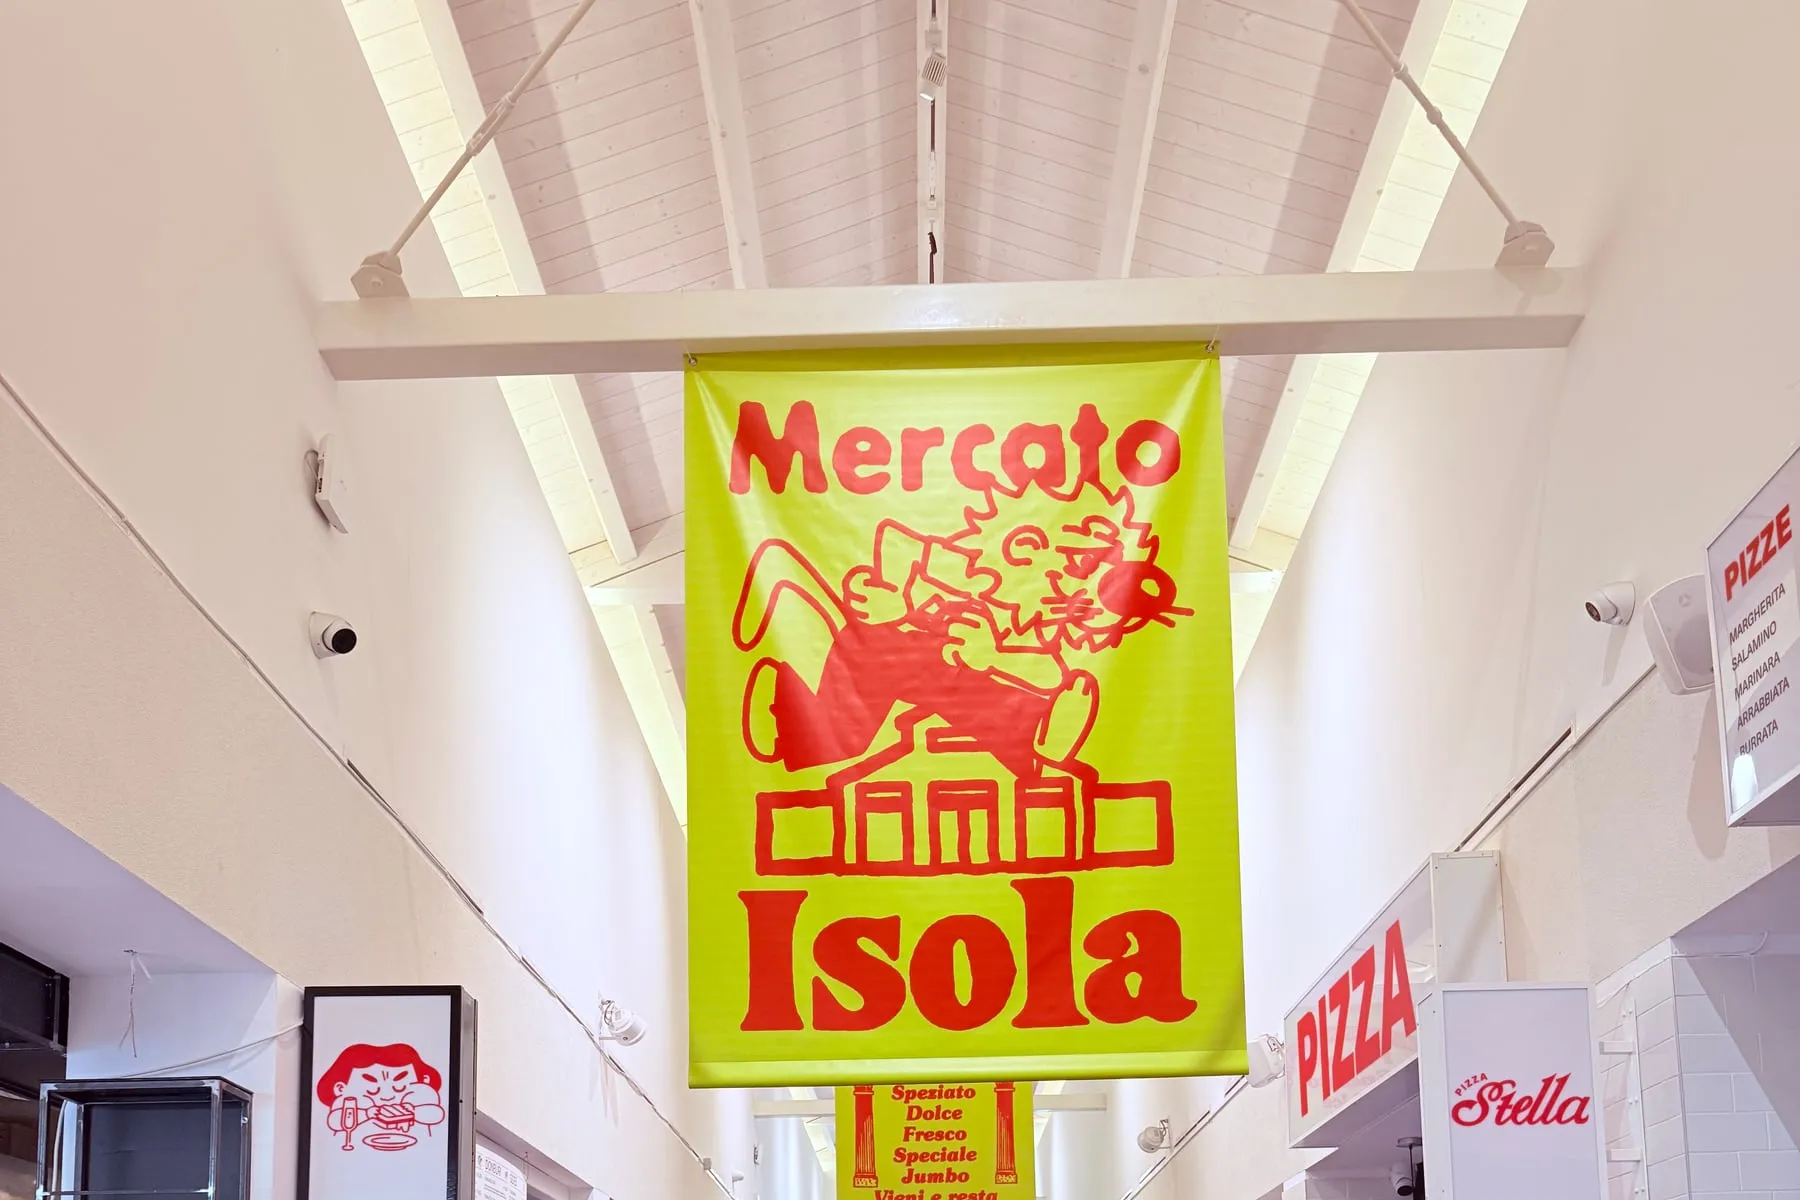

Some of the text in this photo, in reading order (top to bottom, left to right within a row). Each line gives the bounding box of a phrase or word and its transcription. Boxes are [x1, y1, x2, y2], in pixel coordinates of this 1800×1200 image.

[729, 400, 1181, 495] Mercato
[1724, 504, 1793, 602] PIZZE
[1729, 582, 1786, 644] MARGHERITA
[1731, 621, 1777, 671] SALAMINO
[1735, 651, 1780, 701] MARINARA
[1737, 676, 1790, 731] ARRABBIATA
[738, 876, 1198, 1032] Isola
[1297, 919, 1417, 1118] PIZZA
[891, 1084, 977, 1102] Speziato
[1452, 1072, 1590, 1127] Stella
[1455, 1072, 1488, 1097] PIZZA
[902, 1126, 968, 1142] Fresco
[906, 1105, 963, 1122] Dolce
[893, 1147, 977, 1164] Speciale
[900, 1168, 970, 1185] Jumbo
